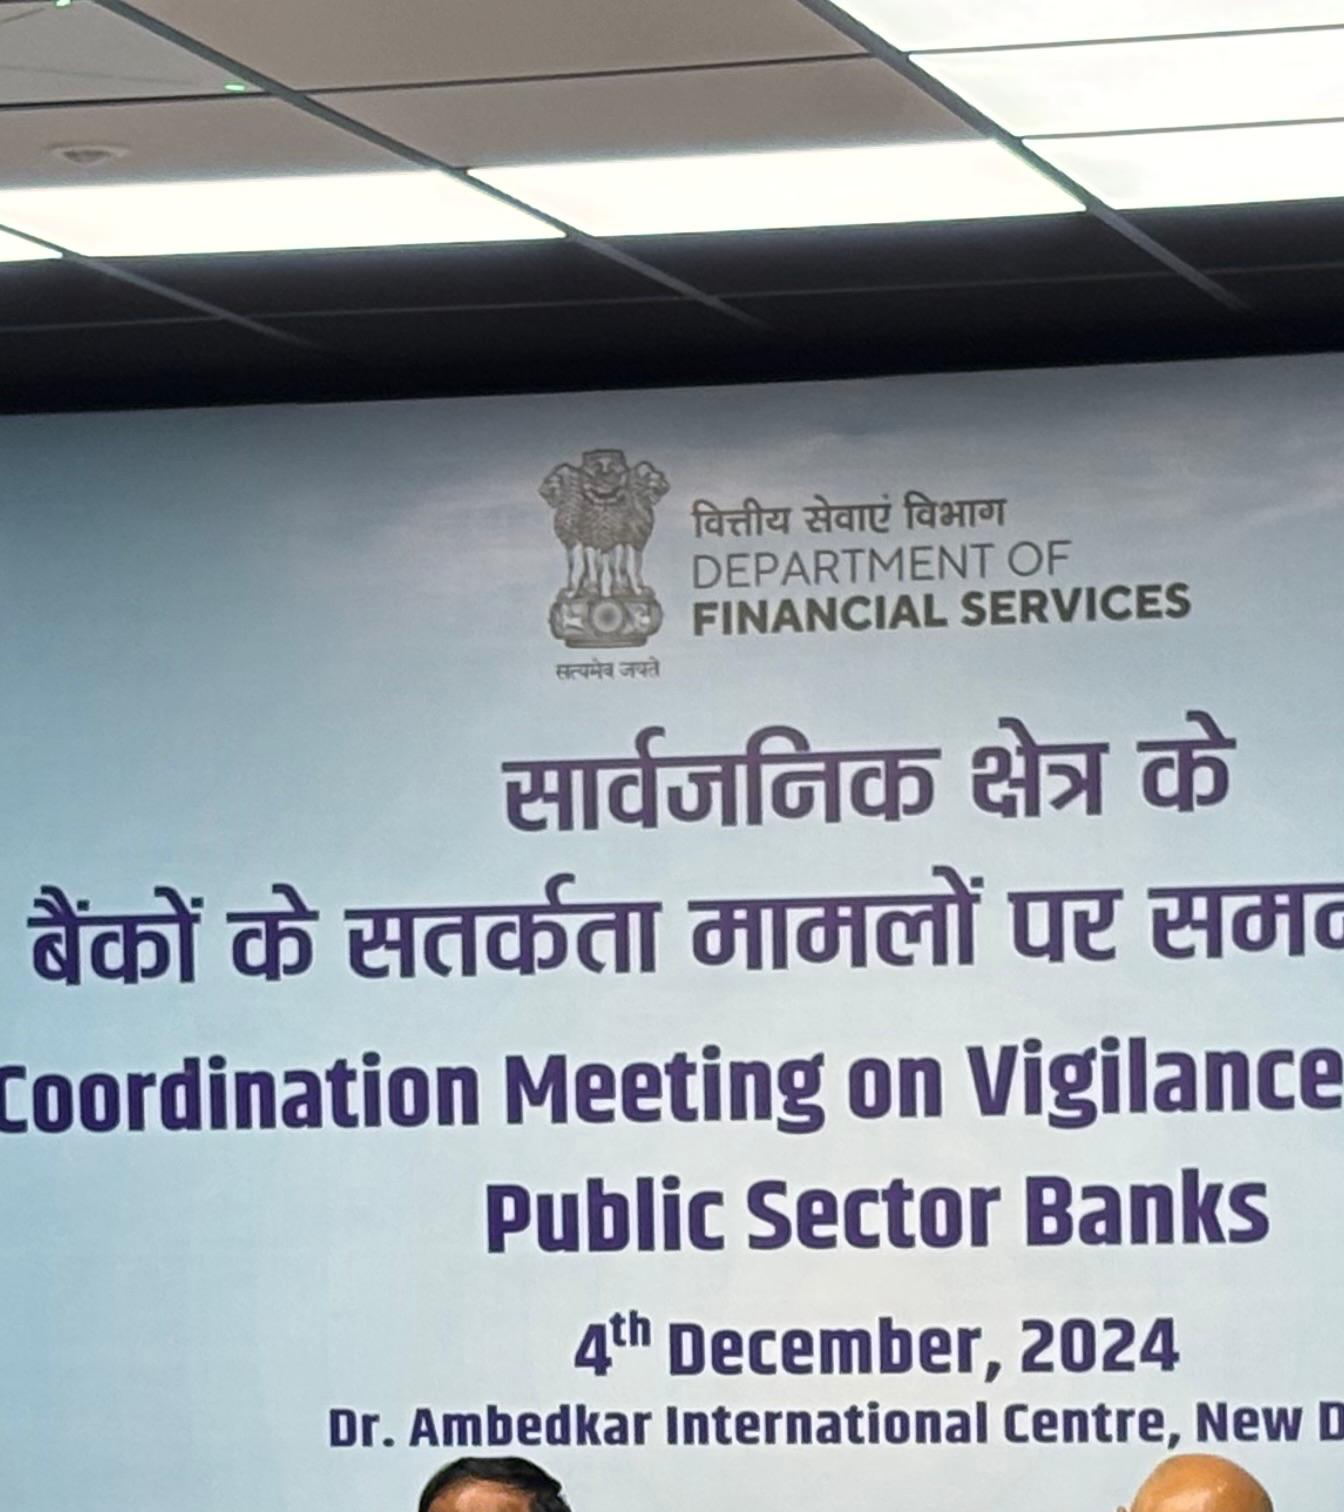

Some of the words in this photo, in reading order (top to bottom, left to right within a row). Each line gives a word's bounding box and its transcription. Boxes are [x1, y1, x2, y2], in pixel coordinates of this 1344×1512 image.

[692, 497, 792, 537] वित्तीय
[803, 494, 892, 533] सेवाएं
[904, 490, 1007, 529] विभाग
[694, 543, 994, 588] DEPARTMENT
[1008, 540, 1071, 576] OF
[694, 594, 947, 635] FINANCIAL
[962, 583, 1191, 626] SERVICES
[501, 726, 941, 831] सार्वजनिक
[973, 717, 1109, 818] क्षेत्र
[1137, 710, 1236, 812] के
[27, 886, 203, 985] बैंकों
[226, 884, 319, 981] के
[344, 873, 662, 978] सतर्कता
[688, 866, 983, 970] मामलों
[1008, 889, 1121, 962] पर
[506, 1045, 825, 1134] Meeting
[849, 1058, 941, 1119] on
[967, 1036, 1343, 1129] Vigilance
[487, 1175, 724, 1253] Public
[748, 1179, 1001, 1250] Sector
[1026, 1168, 1269, 1245] Banks
[575, 1310, 650, 1376] 4th
[670, 1317, 1000, 1382] December,
[1022, 1318, 1179, 1372] 2024
[330, 1409, 394, 1446] Dr.
[410, 1404, 651, 1446] Ambedkar
[667, 1402, 987, 1445] International
[1005, 1404, 1180, 1449] Centre,
[1197, 1403, 1302, 1442] New
